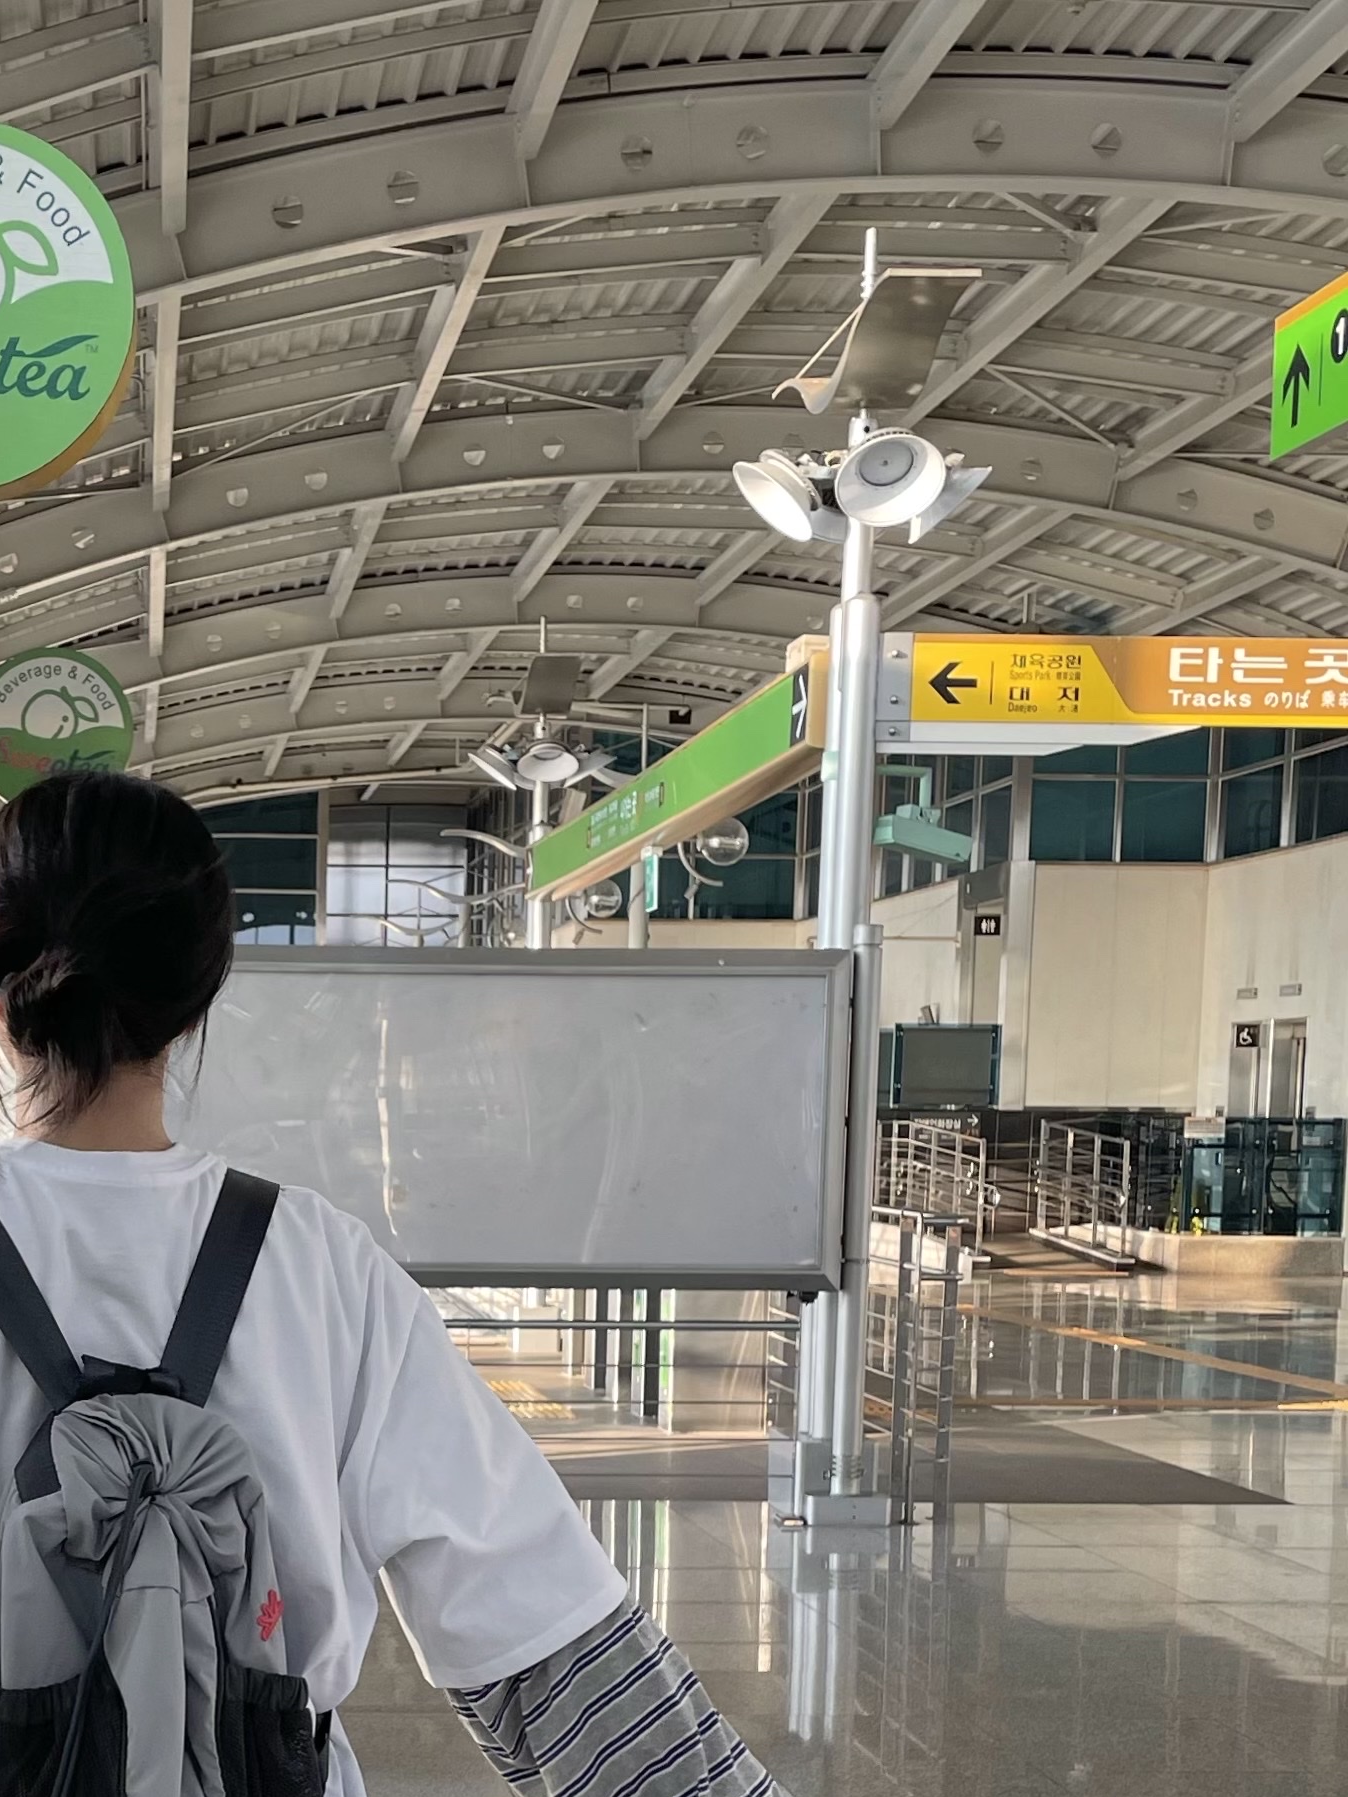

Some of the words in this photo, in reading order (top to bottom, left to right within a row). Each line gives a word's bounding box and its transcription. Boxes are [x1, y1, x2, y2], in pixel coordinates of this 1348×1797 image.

[16, 168, 91, 248] Food
[1168, 646, 1288, 684] 타는
[67, 665, 79, 680] &
[82, 673, 116, 711] Food
[1168, 688, 1252, 707] Tracks
[1264, 689, 1311, 709] のりば
